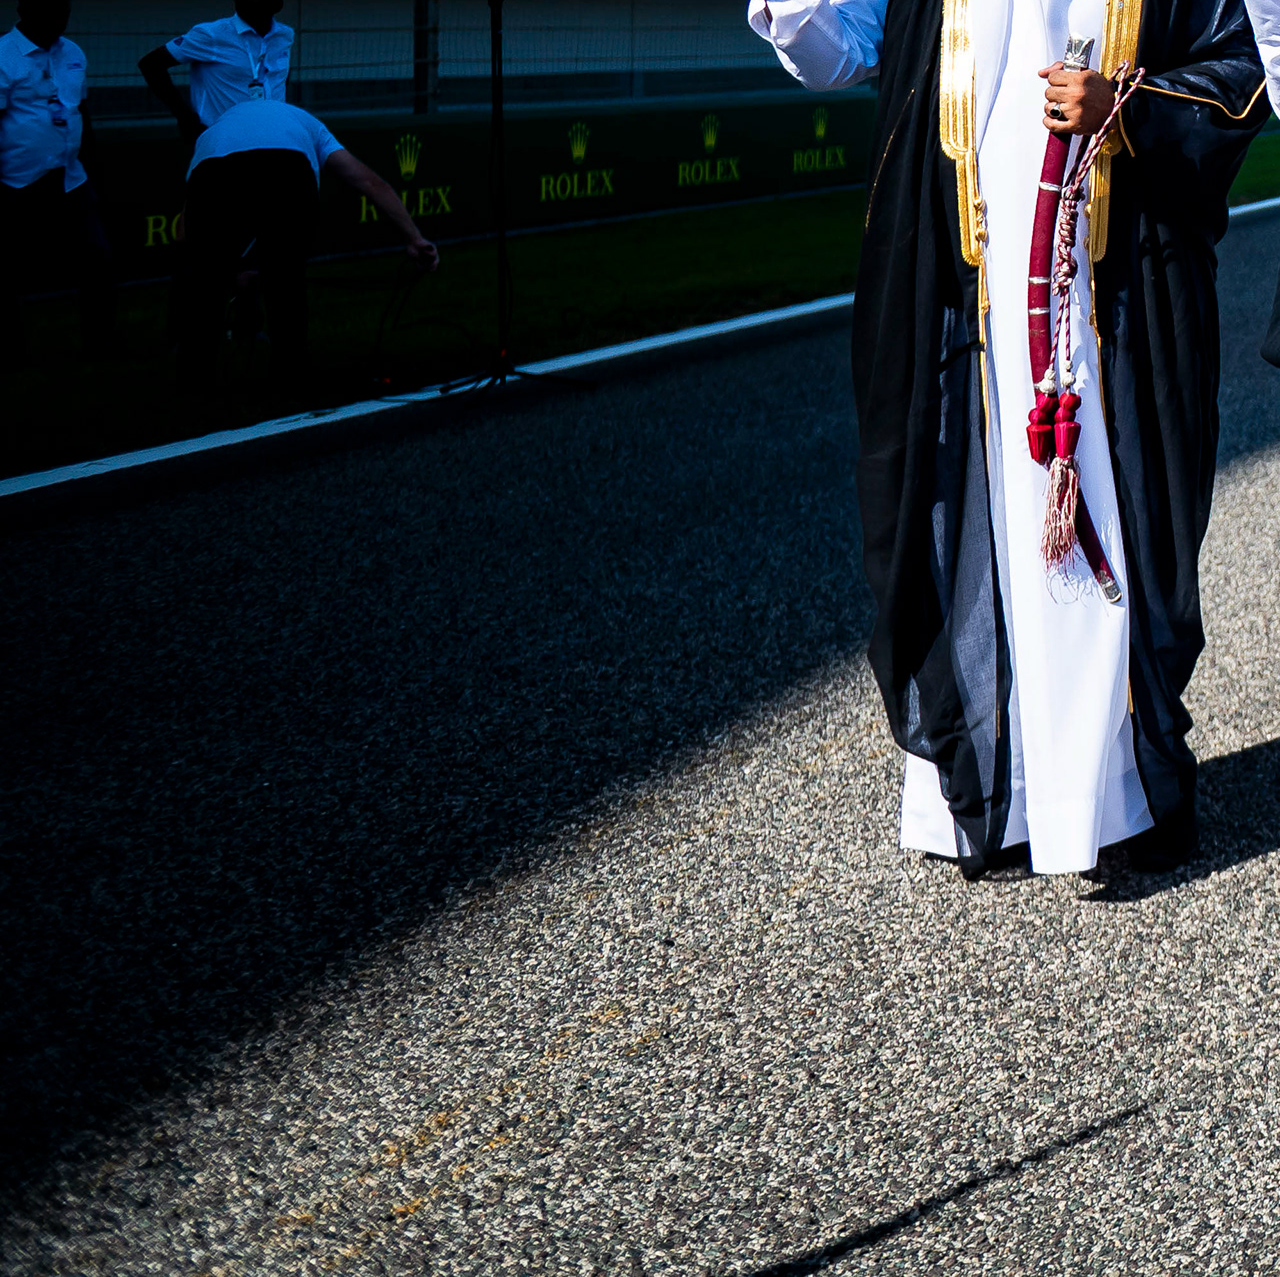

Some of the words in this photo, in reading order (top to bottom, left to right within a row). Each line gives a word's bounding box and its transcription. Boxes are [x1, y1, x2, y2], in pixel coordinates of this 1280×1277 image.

[677, 155, 741, 188] ROLEX
[792, 144, 847, 173] ROLEX
[539, 168, 616, 202] ROLEX
[359, 184, 453, 224] RLEX
